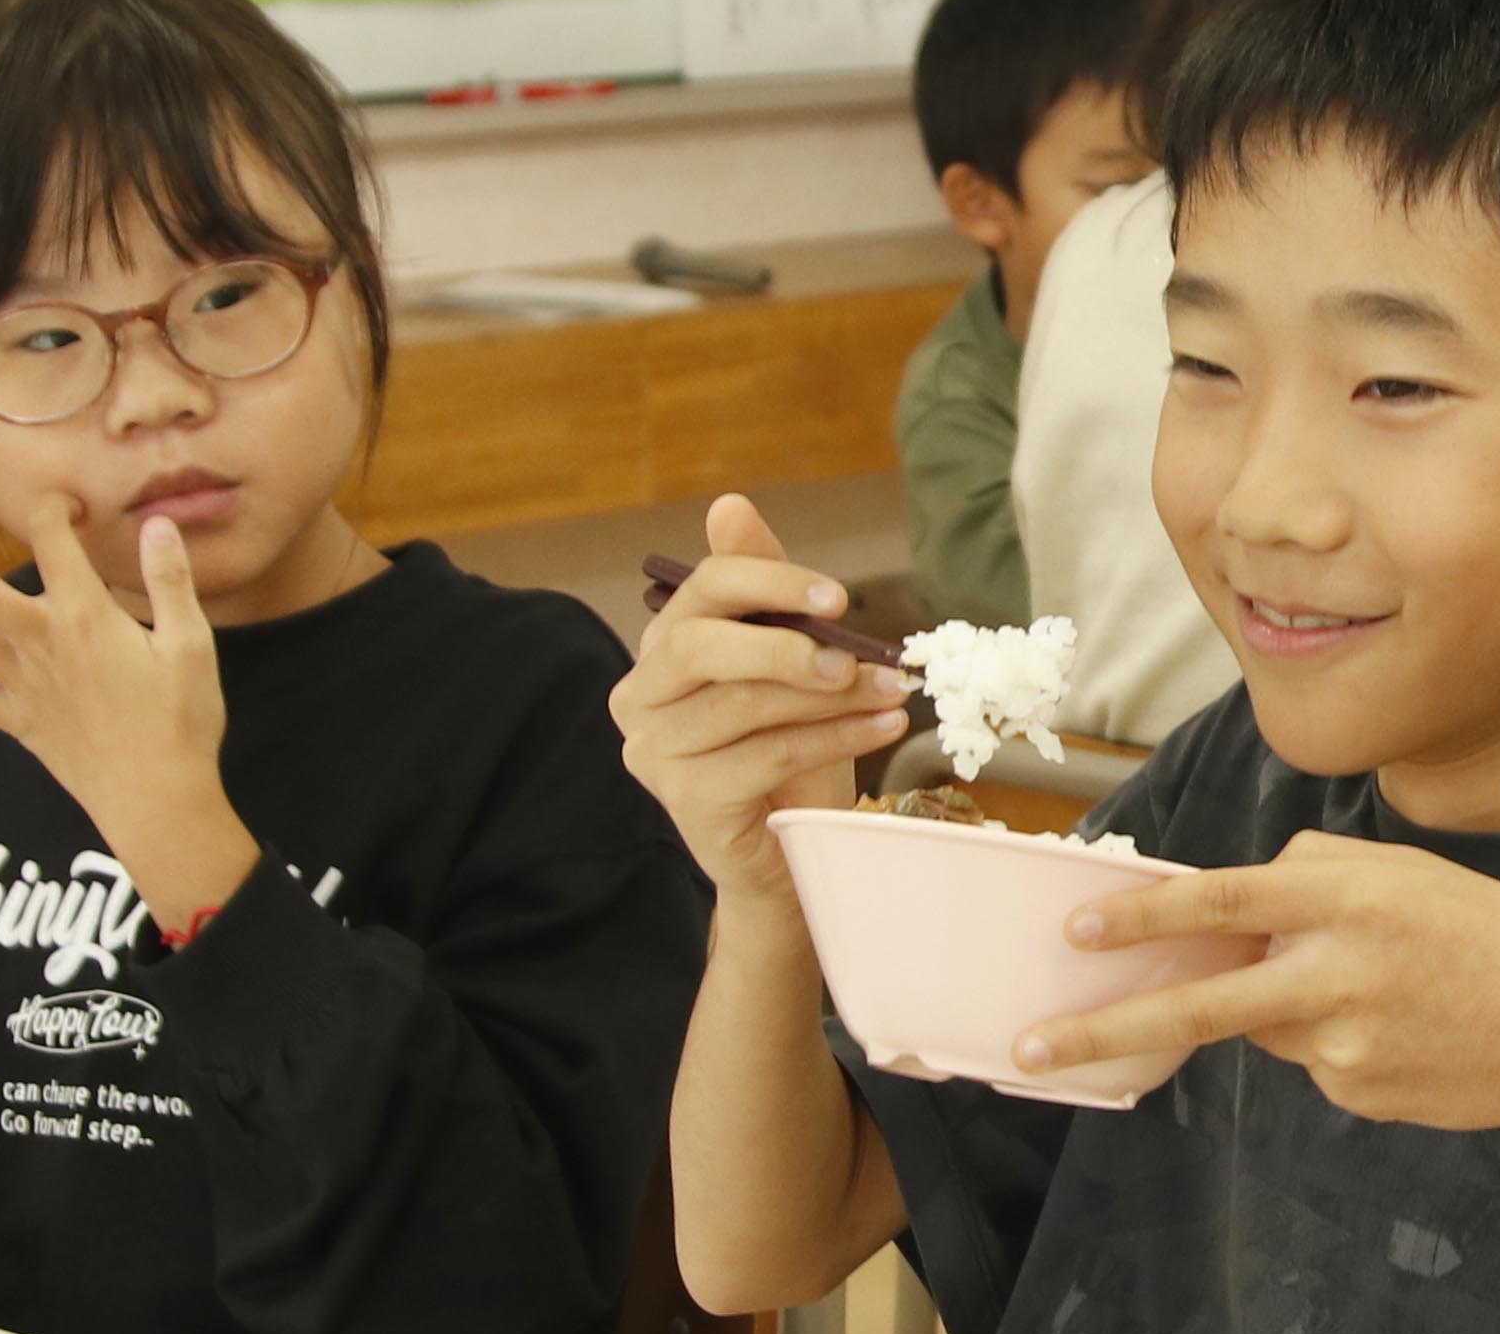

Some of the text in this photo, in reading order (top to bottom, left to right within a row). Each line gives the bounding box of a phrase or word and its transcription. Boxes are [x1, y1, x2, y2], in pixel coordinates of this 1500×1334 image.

[6, 993, 160, 1051] Happy Tour
[2, 1080, 40, 1103] can
[0, 1108, 30, 1136] Go
